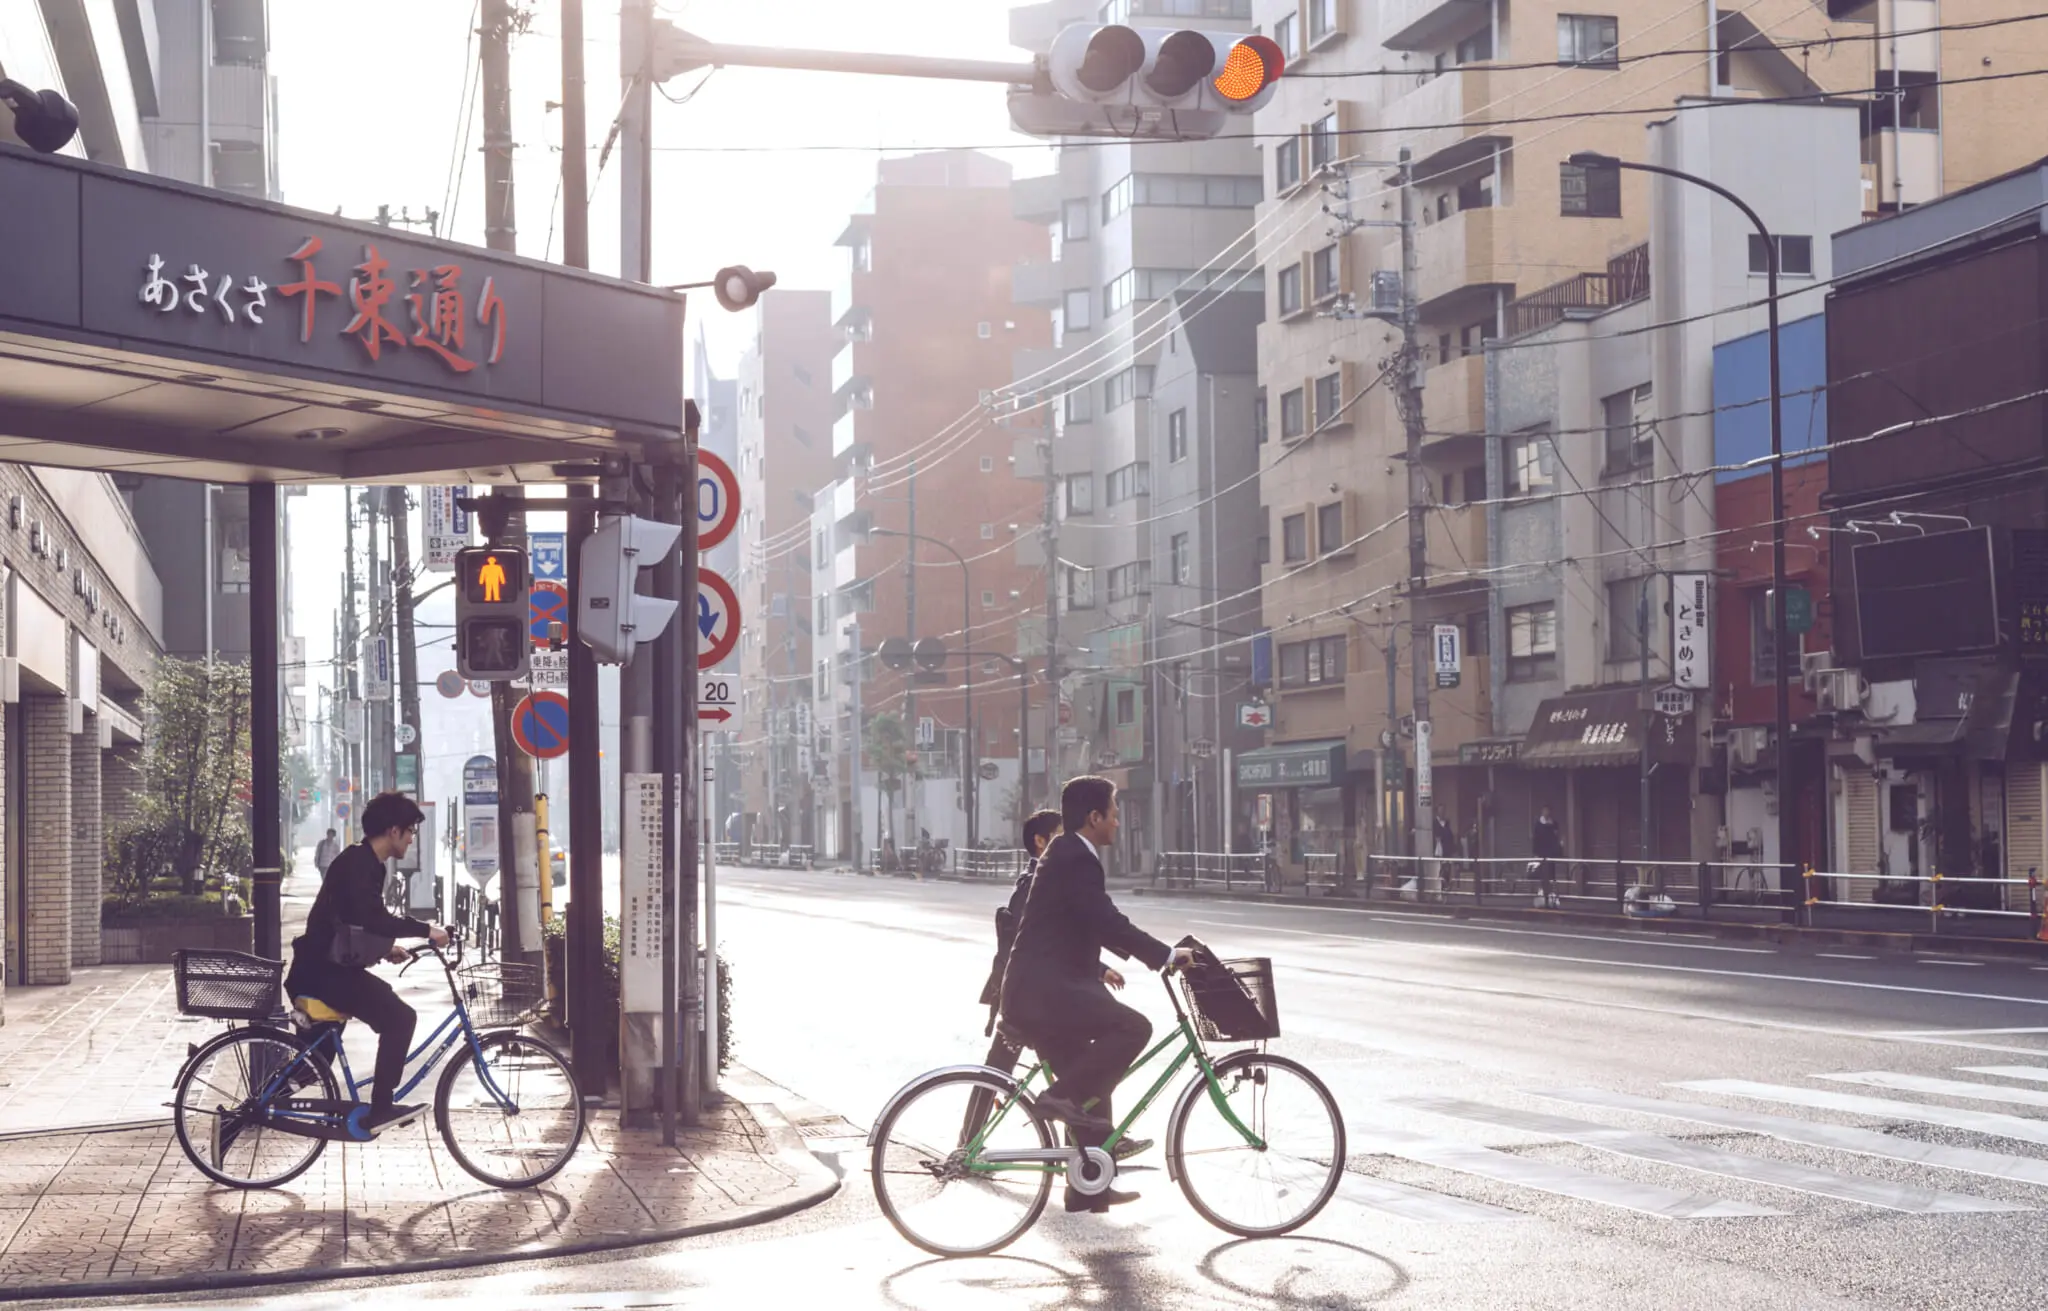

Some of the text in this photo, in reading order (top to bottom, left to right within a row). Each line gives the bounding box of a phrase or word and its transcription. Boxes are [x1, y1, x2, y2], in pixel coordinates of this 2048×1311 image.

[138, 235, 507, 373] あさくさ 千束通り
[698, 478, 718, 521] 0
[1679, 604, 1694, 683] ときめき
[705, 682, 729, 701] 20
